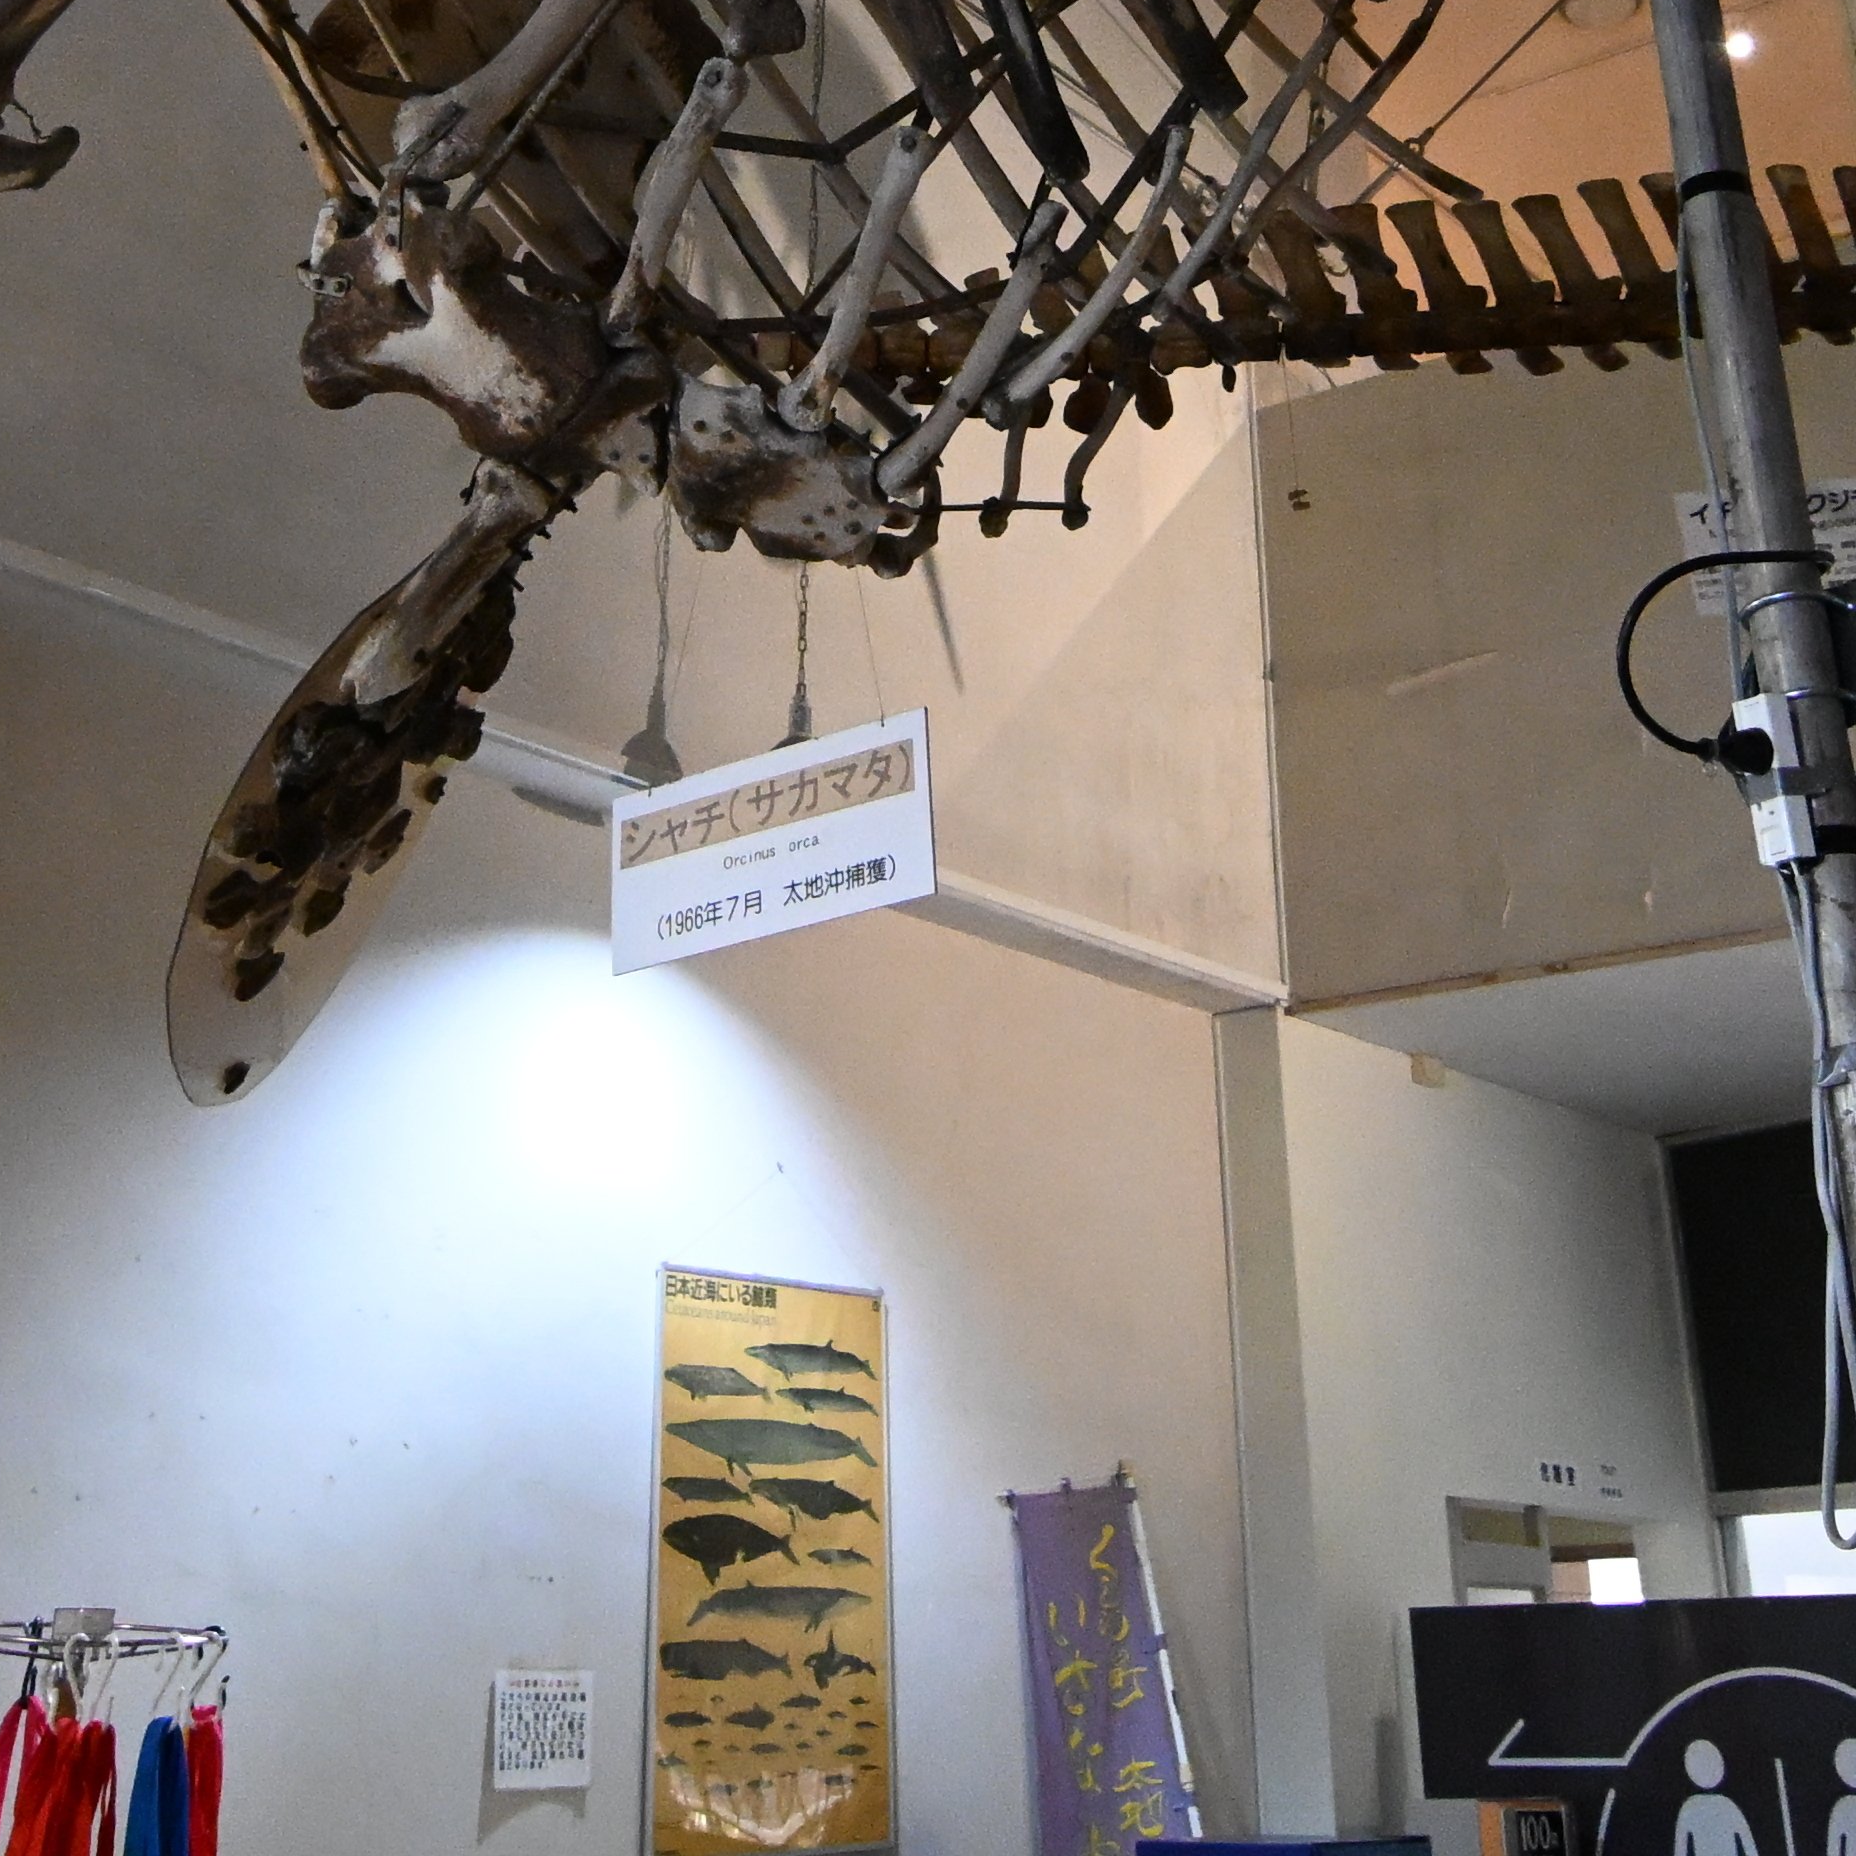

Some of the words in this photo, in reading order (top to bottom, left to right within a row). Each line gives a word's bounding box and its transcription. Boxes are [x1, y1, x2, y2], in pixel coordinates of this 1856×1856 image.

[625, 744, 912, 862] シャチ(サカマタ)
[723, 846, 776, 870] Orcinus
[788, 834, 820, 852] orca
[665, 1275, 776, 1310] 日本近海にいる鯨類
